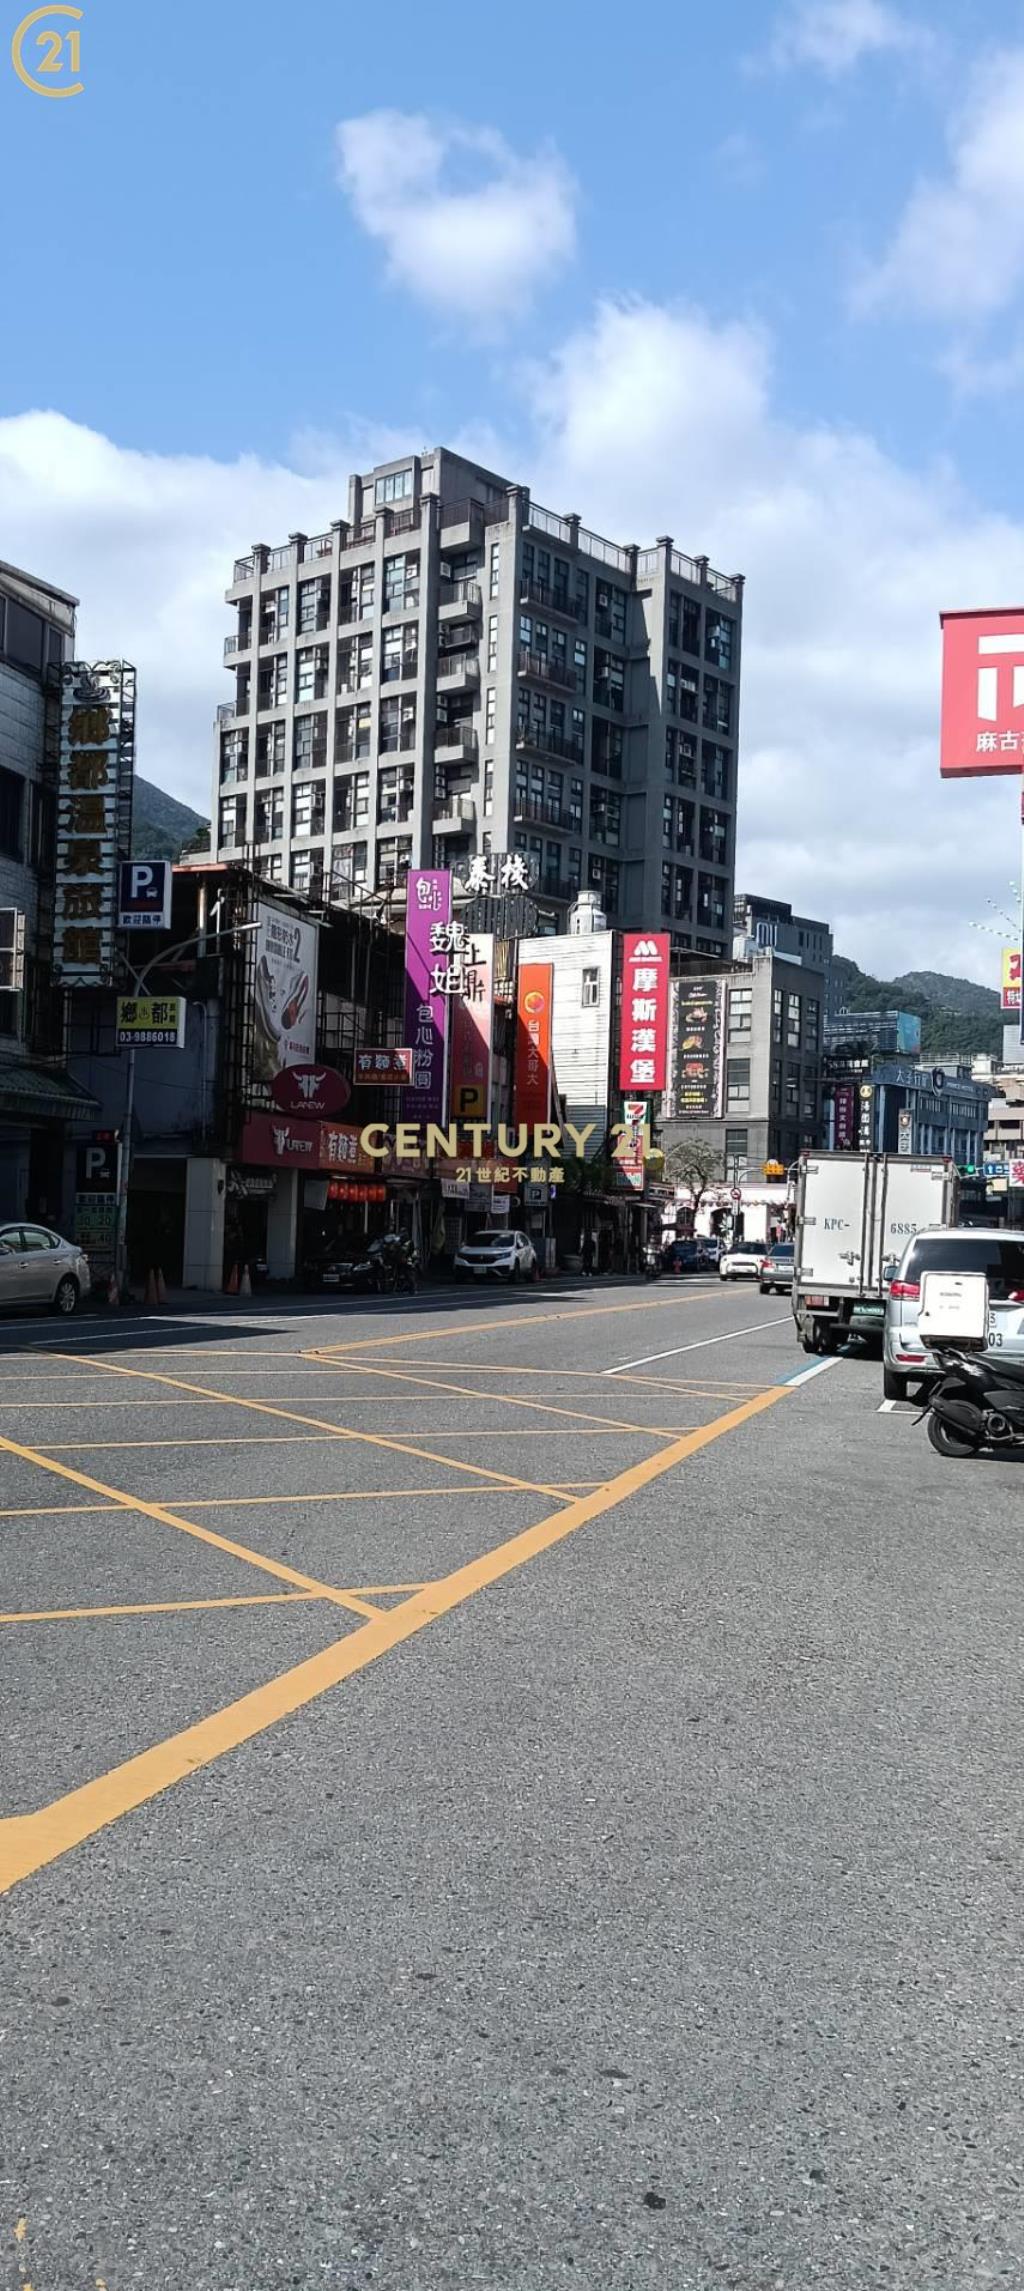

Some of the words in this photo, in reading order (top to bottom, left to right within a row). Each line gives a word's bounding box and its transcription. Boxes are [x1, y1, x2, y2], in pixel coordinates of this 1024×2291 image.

[976, 731, 1024, 752] 麻古
[131, 865, 153, 898] P
[429, 920, 470, 994] 魏姐
[630, 968, 658, 1083] 摩斯漢堡
[414, 1004, 433, 1089] 包心粉圓
[460, 1088, 478, 1112] P
[85, 1147, 106, 1179] P
[824, 1218, 850, 1230] KPC-
